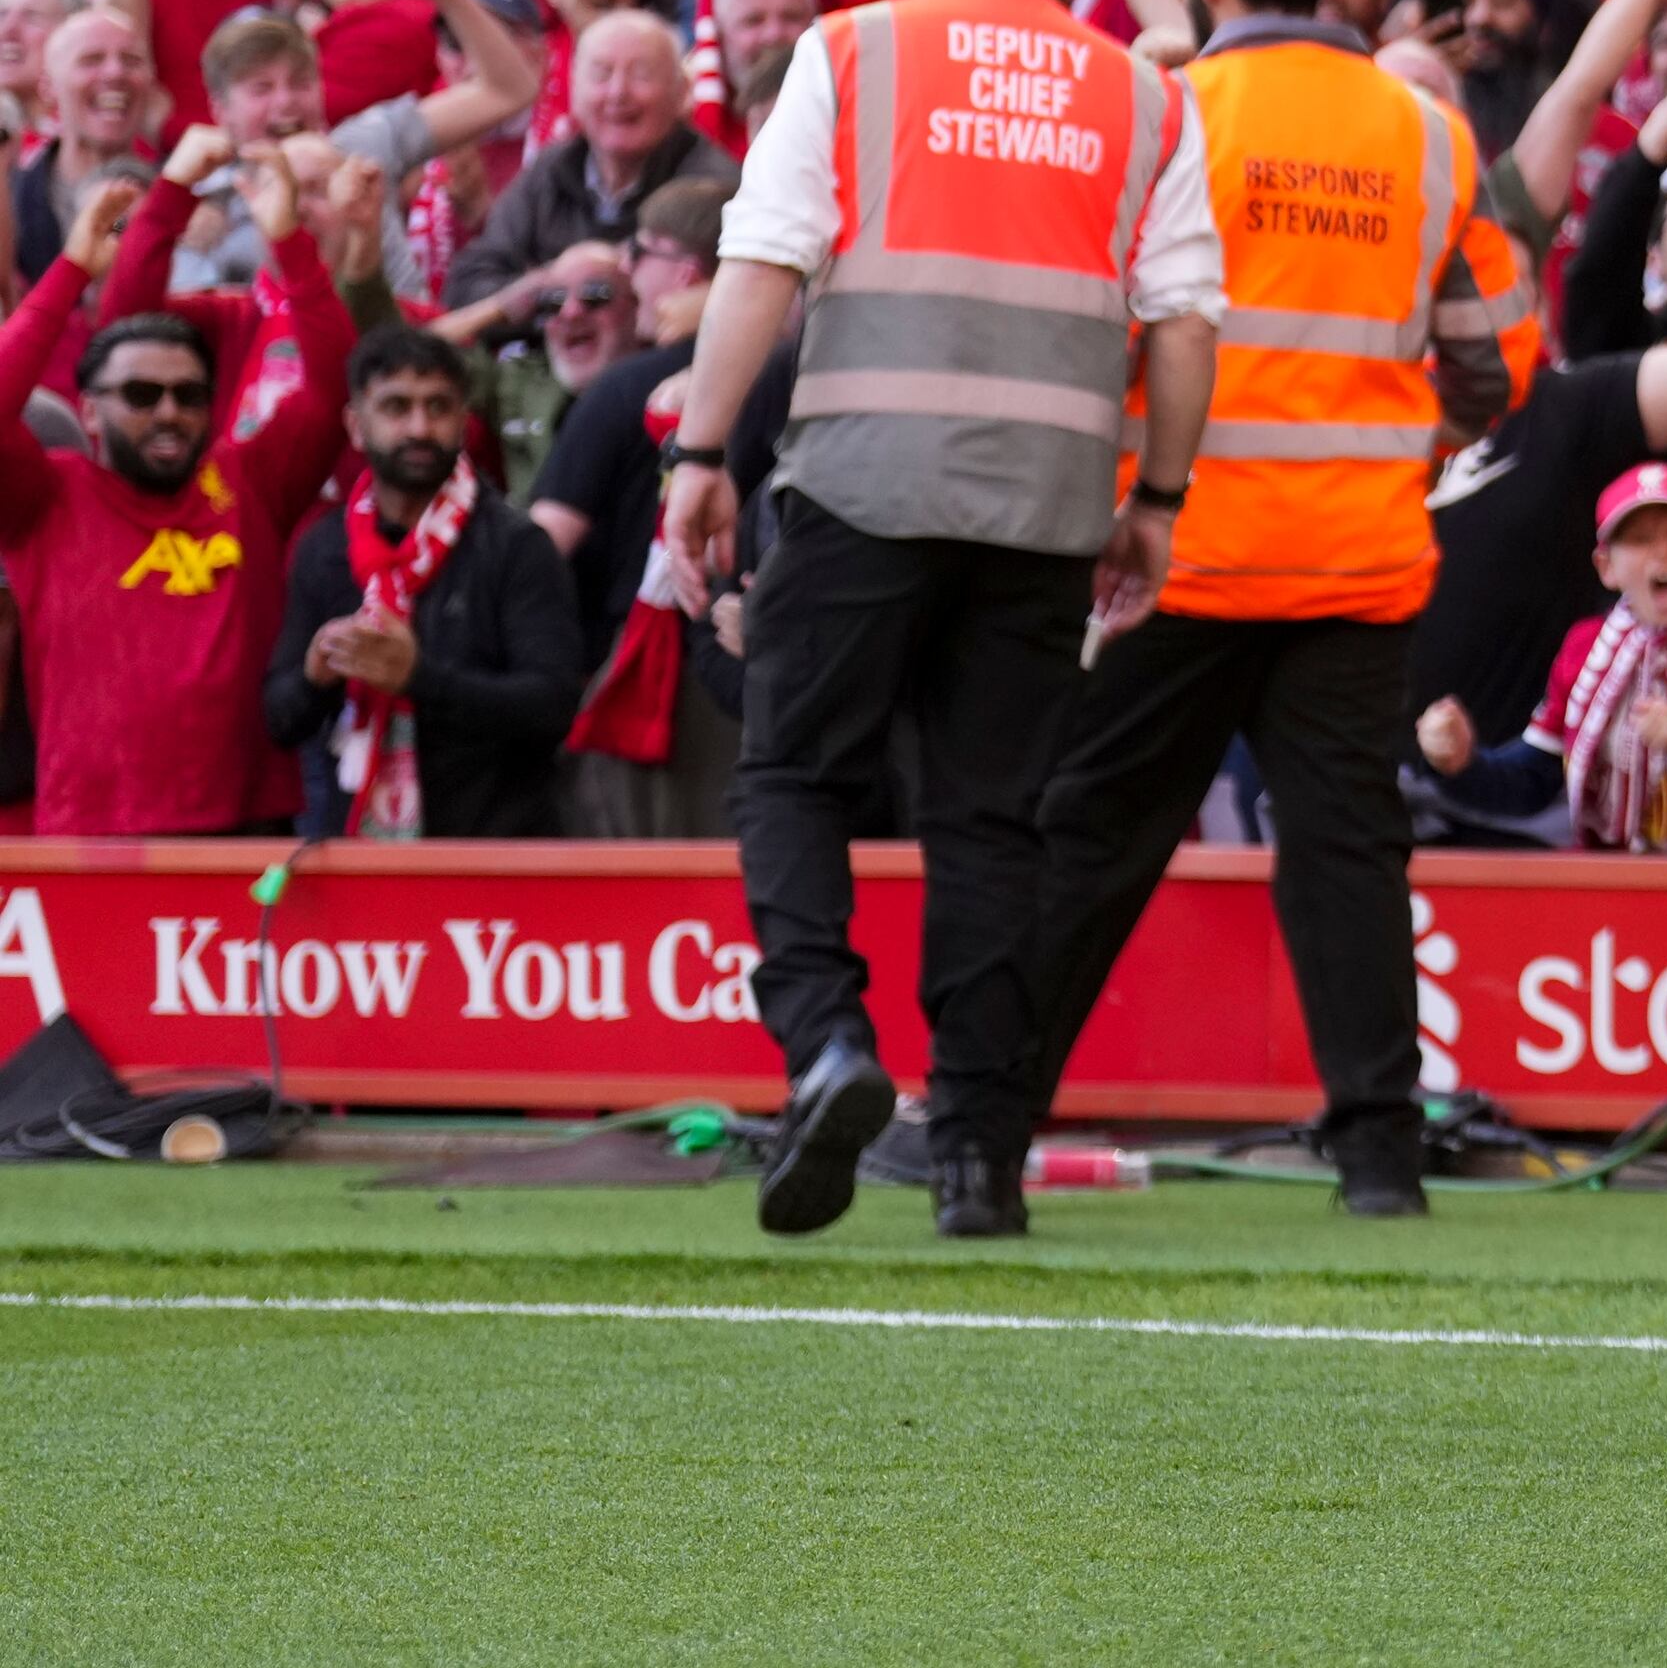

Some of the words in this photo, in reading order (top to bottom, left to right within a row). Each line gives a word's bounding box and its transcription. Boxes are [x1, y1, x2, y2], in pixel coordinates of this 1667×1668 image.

[947, 22, 1088, 80] DEPUTY
[970, 70, 1071, 117] CHIEF
[927, 110, 1102, 173] STEWARD
[1245, 159, 1396, 206] RESPONSE
[1246, 200, 1389, 245] STEWARD
[150, 917, 427, 1019] Know
[443, 919, 629, 1022] You
[647, 920, 764, 1024] Ca
